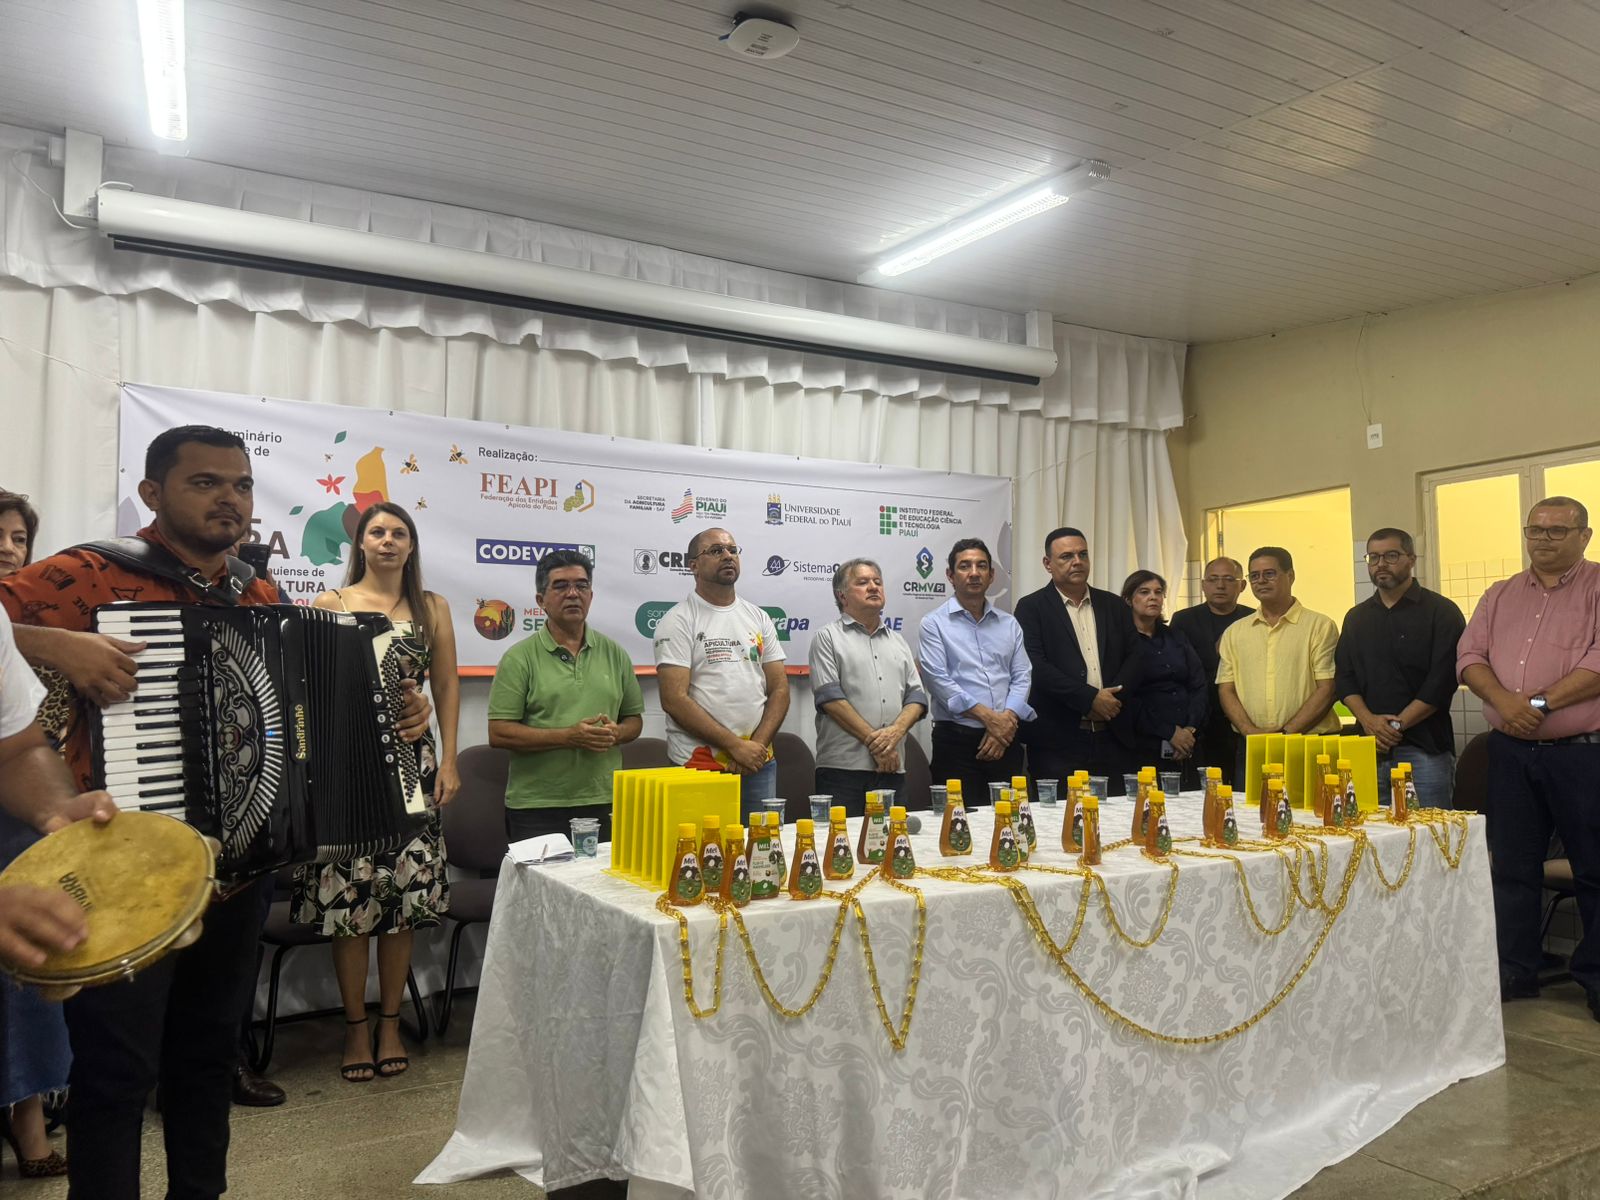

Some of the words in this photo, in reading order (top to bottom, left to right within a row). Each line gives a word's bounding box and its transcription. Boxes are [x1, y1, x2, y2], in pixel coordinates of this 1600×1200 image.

[254, 445, 270, 457] de
[478, 447, 539, 462] Realização:
[480, 472, 559, 498] FEAPI
[784, 503, 841, 516] UNIVERSIDADE
[929, 509, 954, 517] FEDERAL
[784, 514, 817, 525] FEDERAL
[905, 521, 941, 530] TECNOLOGIA
[312, 567, 325, 577] de
[903, 582, 934, 593] CRMV
[836, 836, 847, 844] Mel
[896, 837, 907, 845] Mel
[758, 842, 770, 850] MEL
[706, 847, 718, 855] Mel
[804, 852, 815, 860] Mel
[683, 857, 696, 865] Mel
[736, 859, 746, 867] Mel
